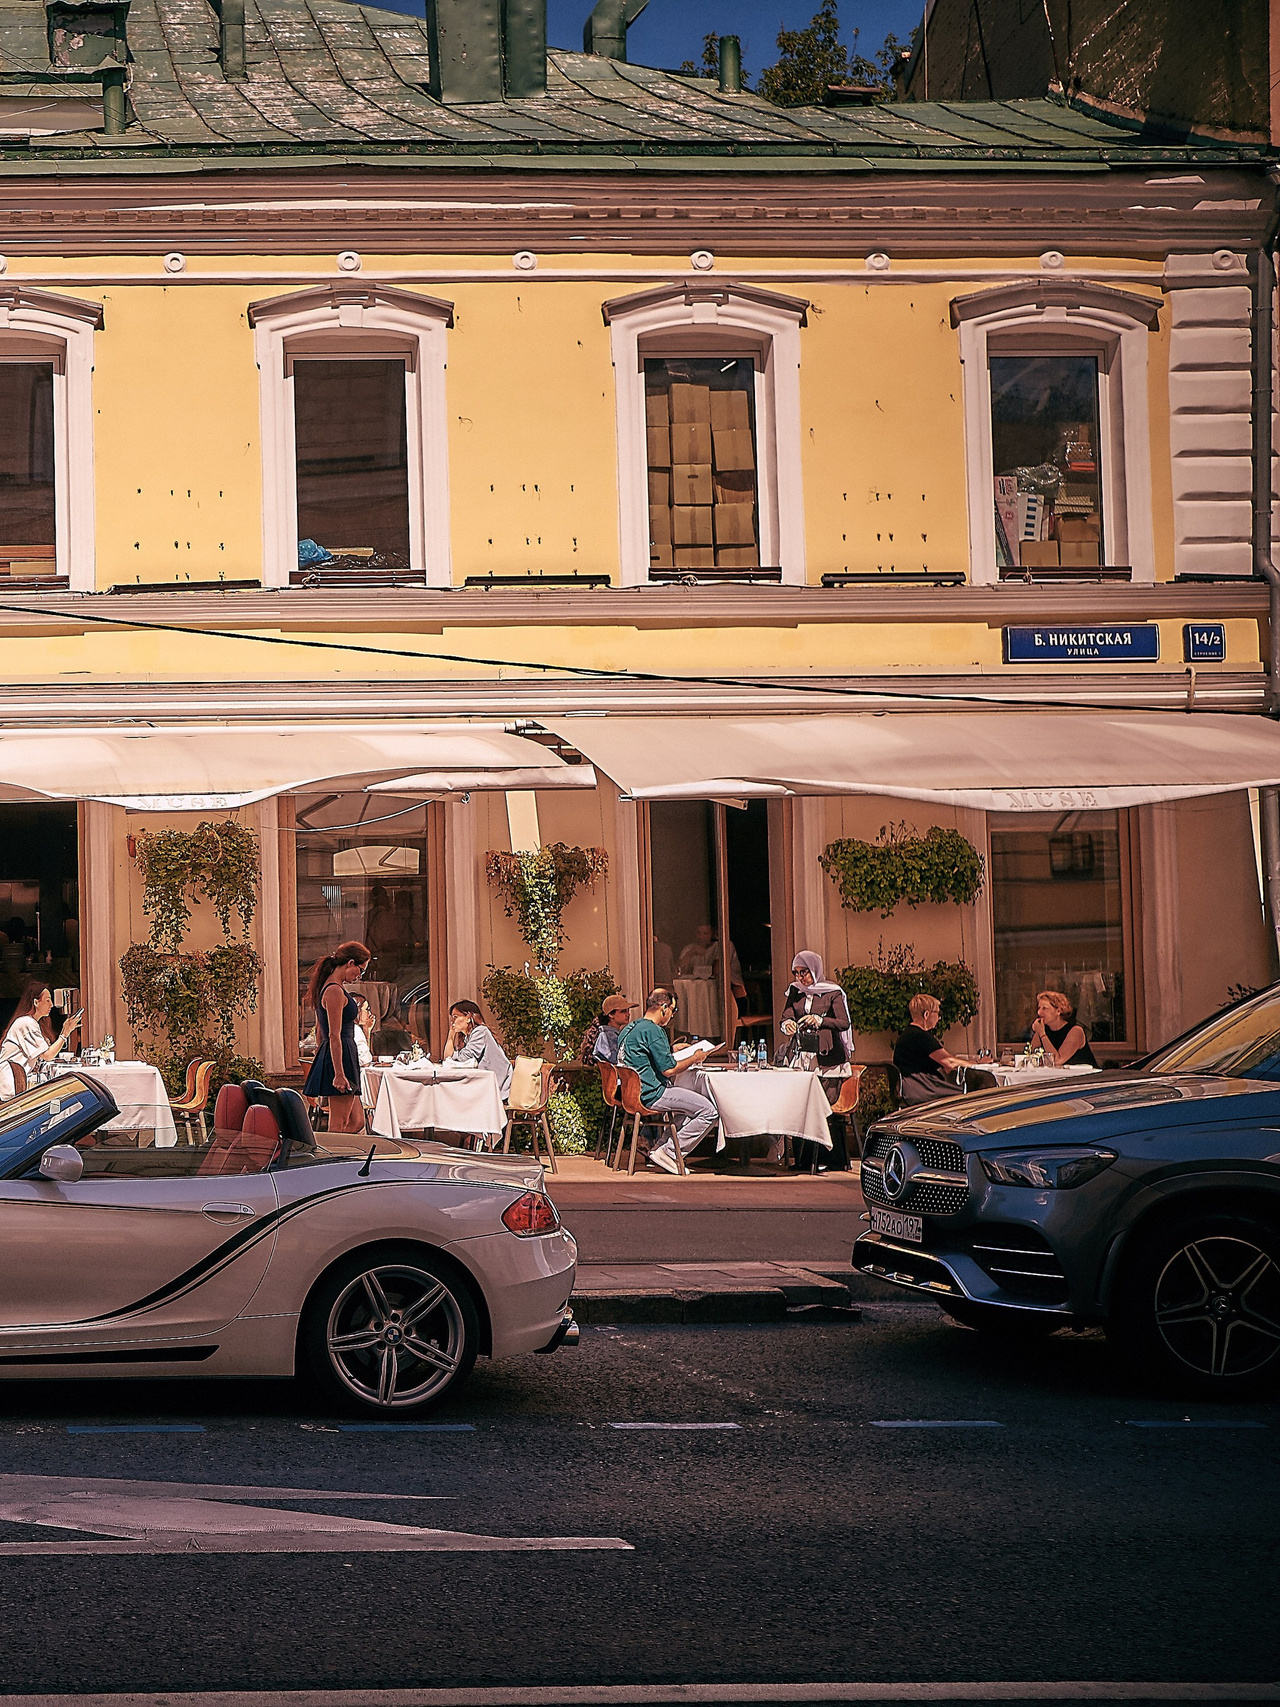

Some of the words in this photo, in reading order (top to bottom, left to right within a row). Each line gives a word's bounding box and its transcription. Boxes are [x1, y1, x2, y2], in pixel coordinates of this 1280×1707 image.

[1034, 633, 1046, 646] Б.
[1049, 632, 1132, 646] НИКИТСКАЯ
[1194, 631, 1221, 646] 14/2
[1067, 648, 1100, 656] УЛИЦА
[137, 797, 228, 809] MUSE
[1006, 791, 1099, 808] MUSE
